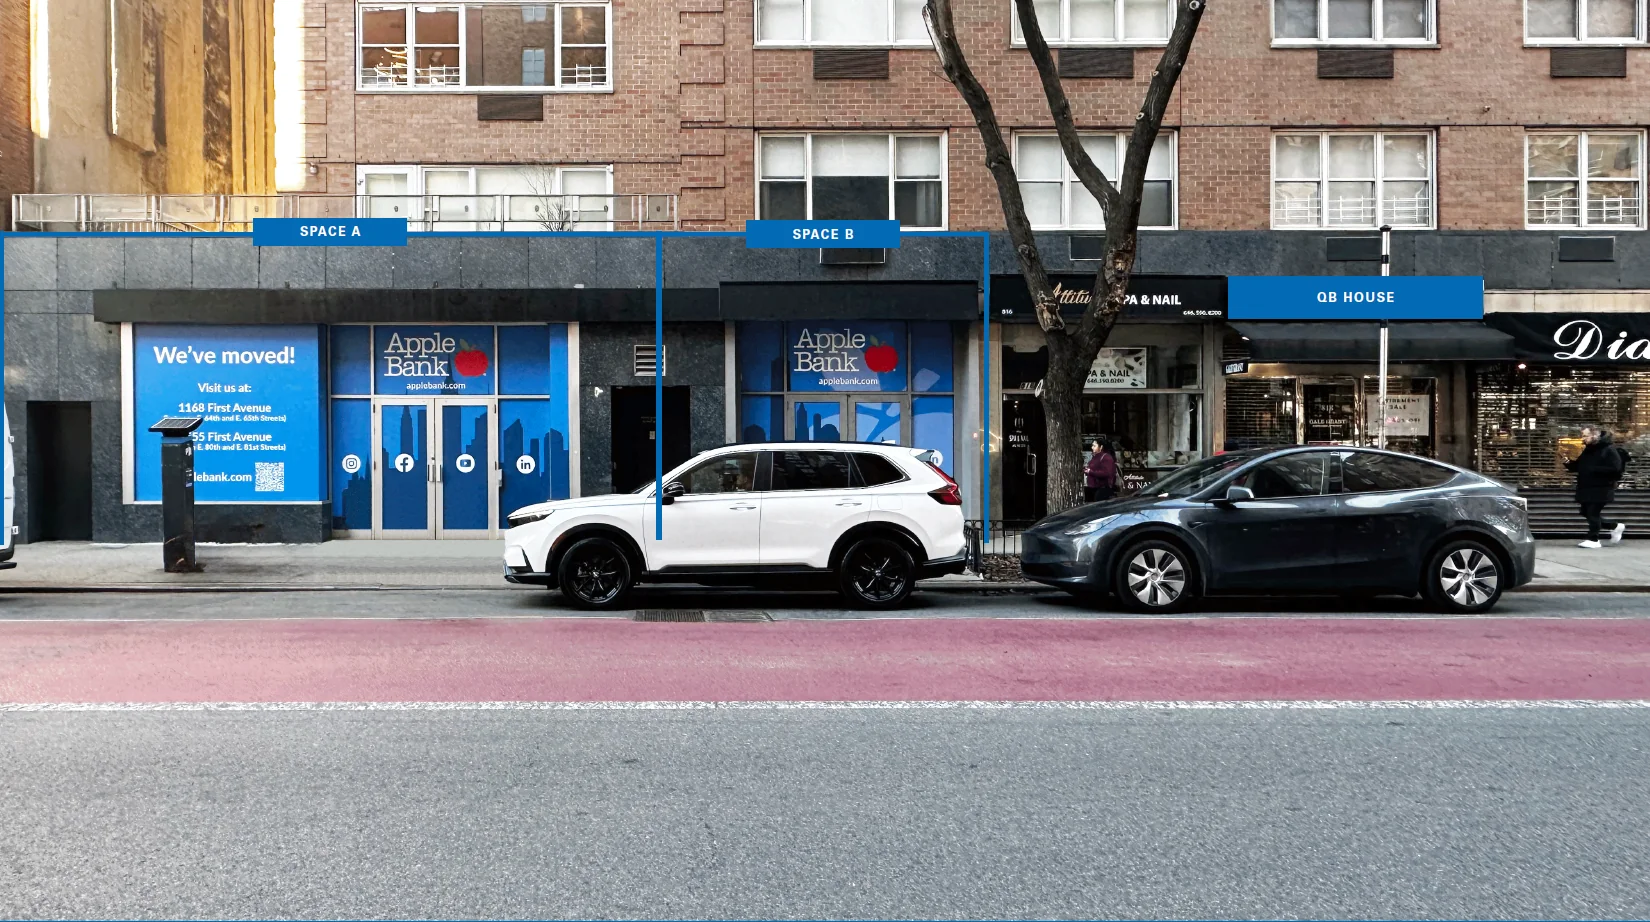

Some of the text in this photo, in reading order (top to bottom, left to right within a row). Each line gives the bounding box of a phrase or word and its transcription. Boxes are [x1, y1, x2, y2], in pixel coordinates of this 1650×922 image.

[1140, 294, 1150, 305] &
[1152, 294, 1182, 305] NAIL
[384, 332, 456, 358] Apple
[793, 328, 866, 354] Apple
[153, 345, 295, 364] We've moved!
[384, 356, 450, 377] Bank
[793, 352, 860, 372] Bank
[1099, 370, 1107, 378] &
[1109, 369, 1131, 377] NAIL
[406, 381, 466, 391] applebank.com
[818, 377, 879, 386] applebank.com
[198, 383, 252, 393] Visit us at:
[178, 403, 272, 413] 1168 First Avenue
[260, 415, 287, 423] Streets)
[208, 432, 231, 442] First
[233, 432, 272, 442] Avenue
[193, 472, 253, 482] lebank.com
